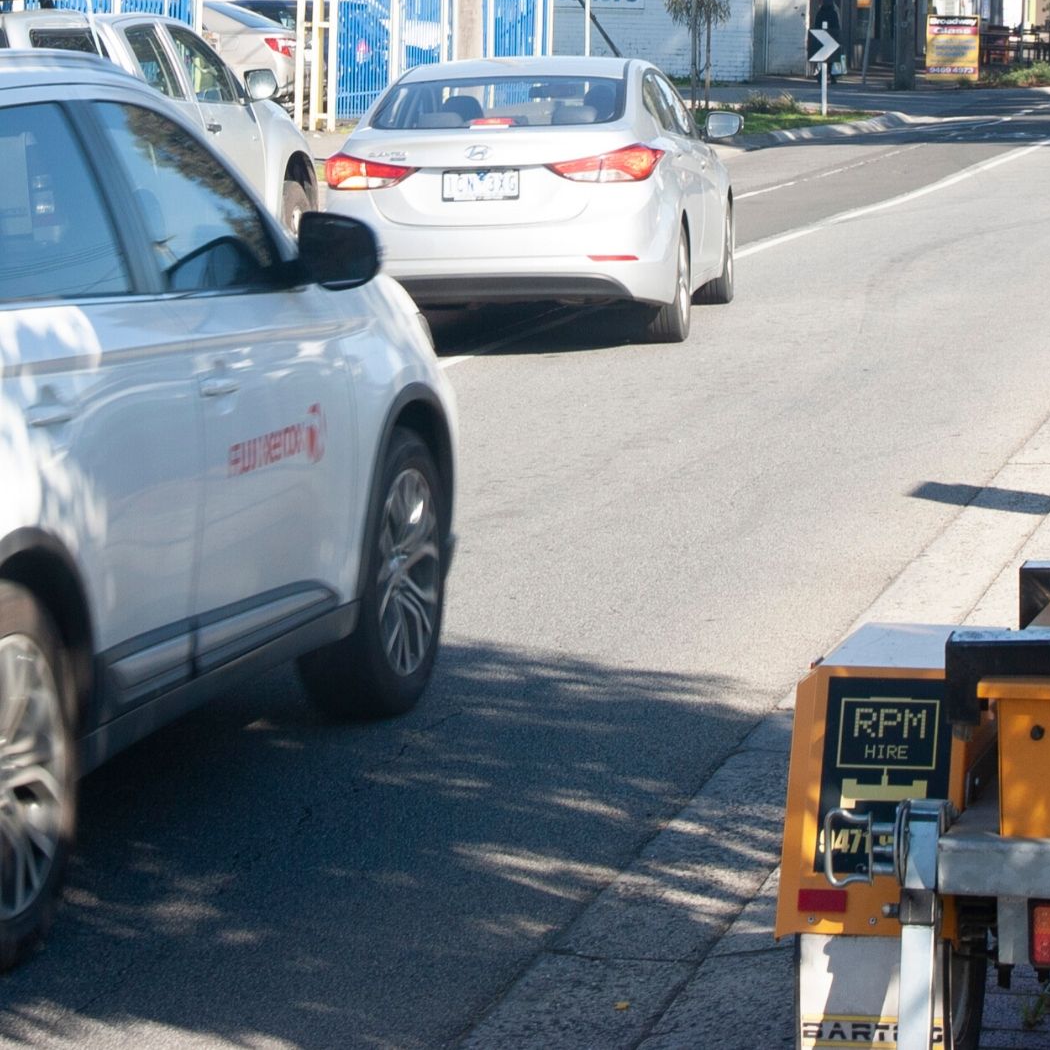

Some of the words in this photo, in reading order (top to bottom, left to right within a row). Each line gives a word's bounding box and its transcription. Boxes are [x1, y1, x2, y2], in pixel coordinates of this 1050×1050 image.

[930, 17, 977, 26] Broadway
[853, 708, 928, 739] RPM
[864, 744, 909, 760] HIRE
[802, 1022, 943, 1042] BART
